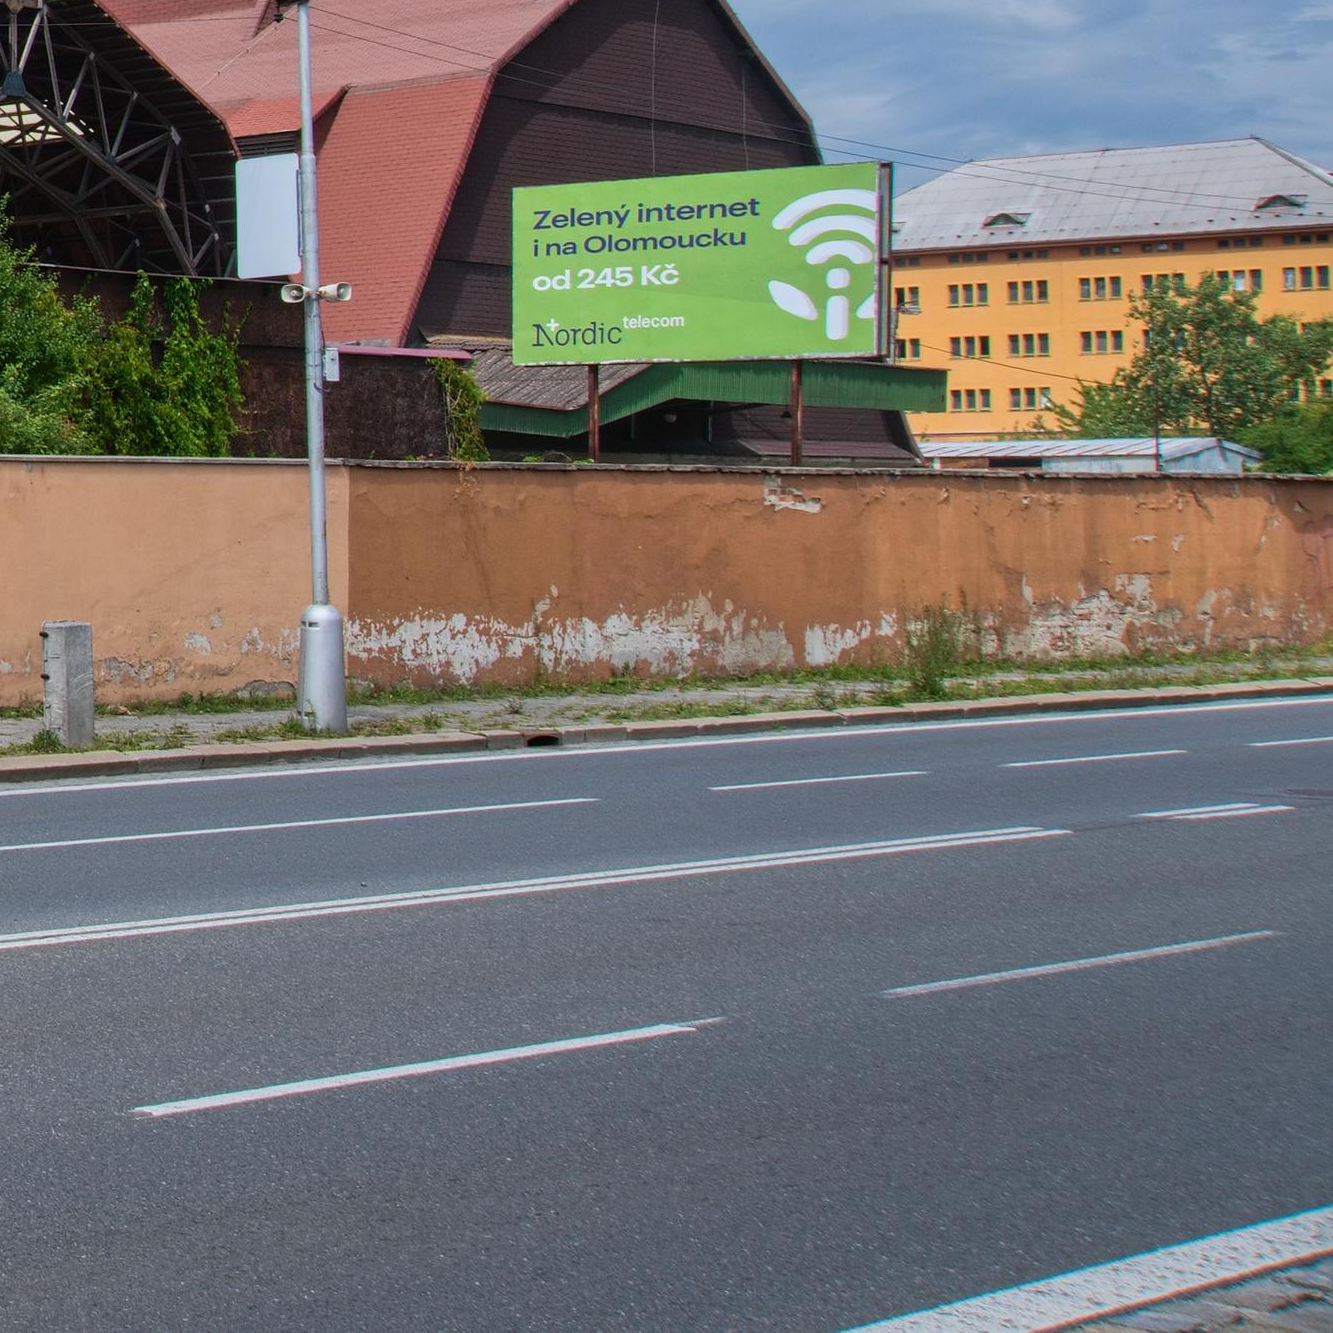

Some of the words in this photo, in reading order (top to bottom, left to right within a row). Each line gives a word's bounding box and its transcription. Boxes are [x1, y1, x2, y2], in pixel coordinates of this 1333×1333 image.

[533, 204, 630, 229] Zelený
[638, 198, 760, 223] internet
[533, 239, 539, 257] i
[545, 241, 577, 256] na
[583, 228, 746, 254] Olomoucku
[532, 269, 571, 291] od
[576, 267, 633, 289] 245
[640, 264, 679, 286] Kč
[532, 321, 622, 347] Nordic
[622, 315, 685, 329] telecom
